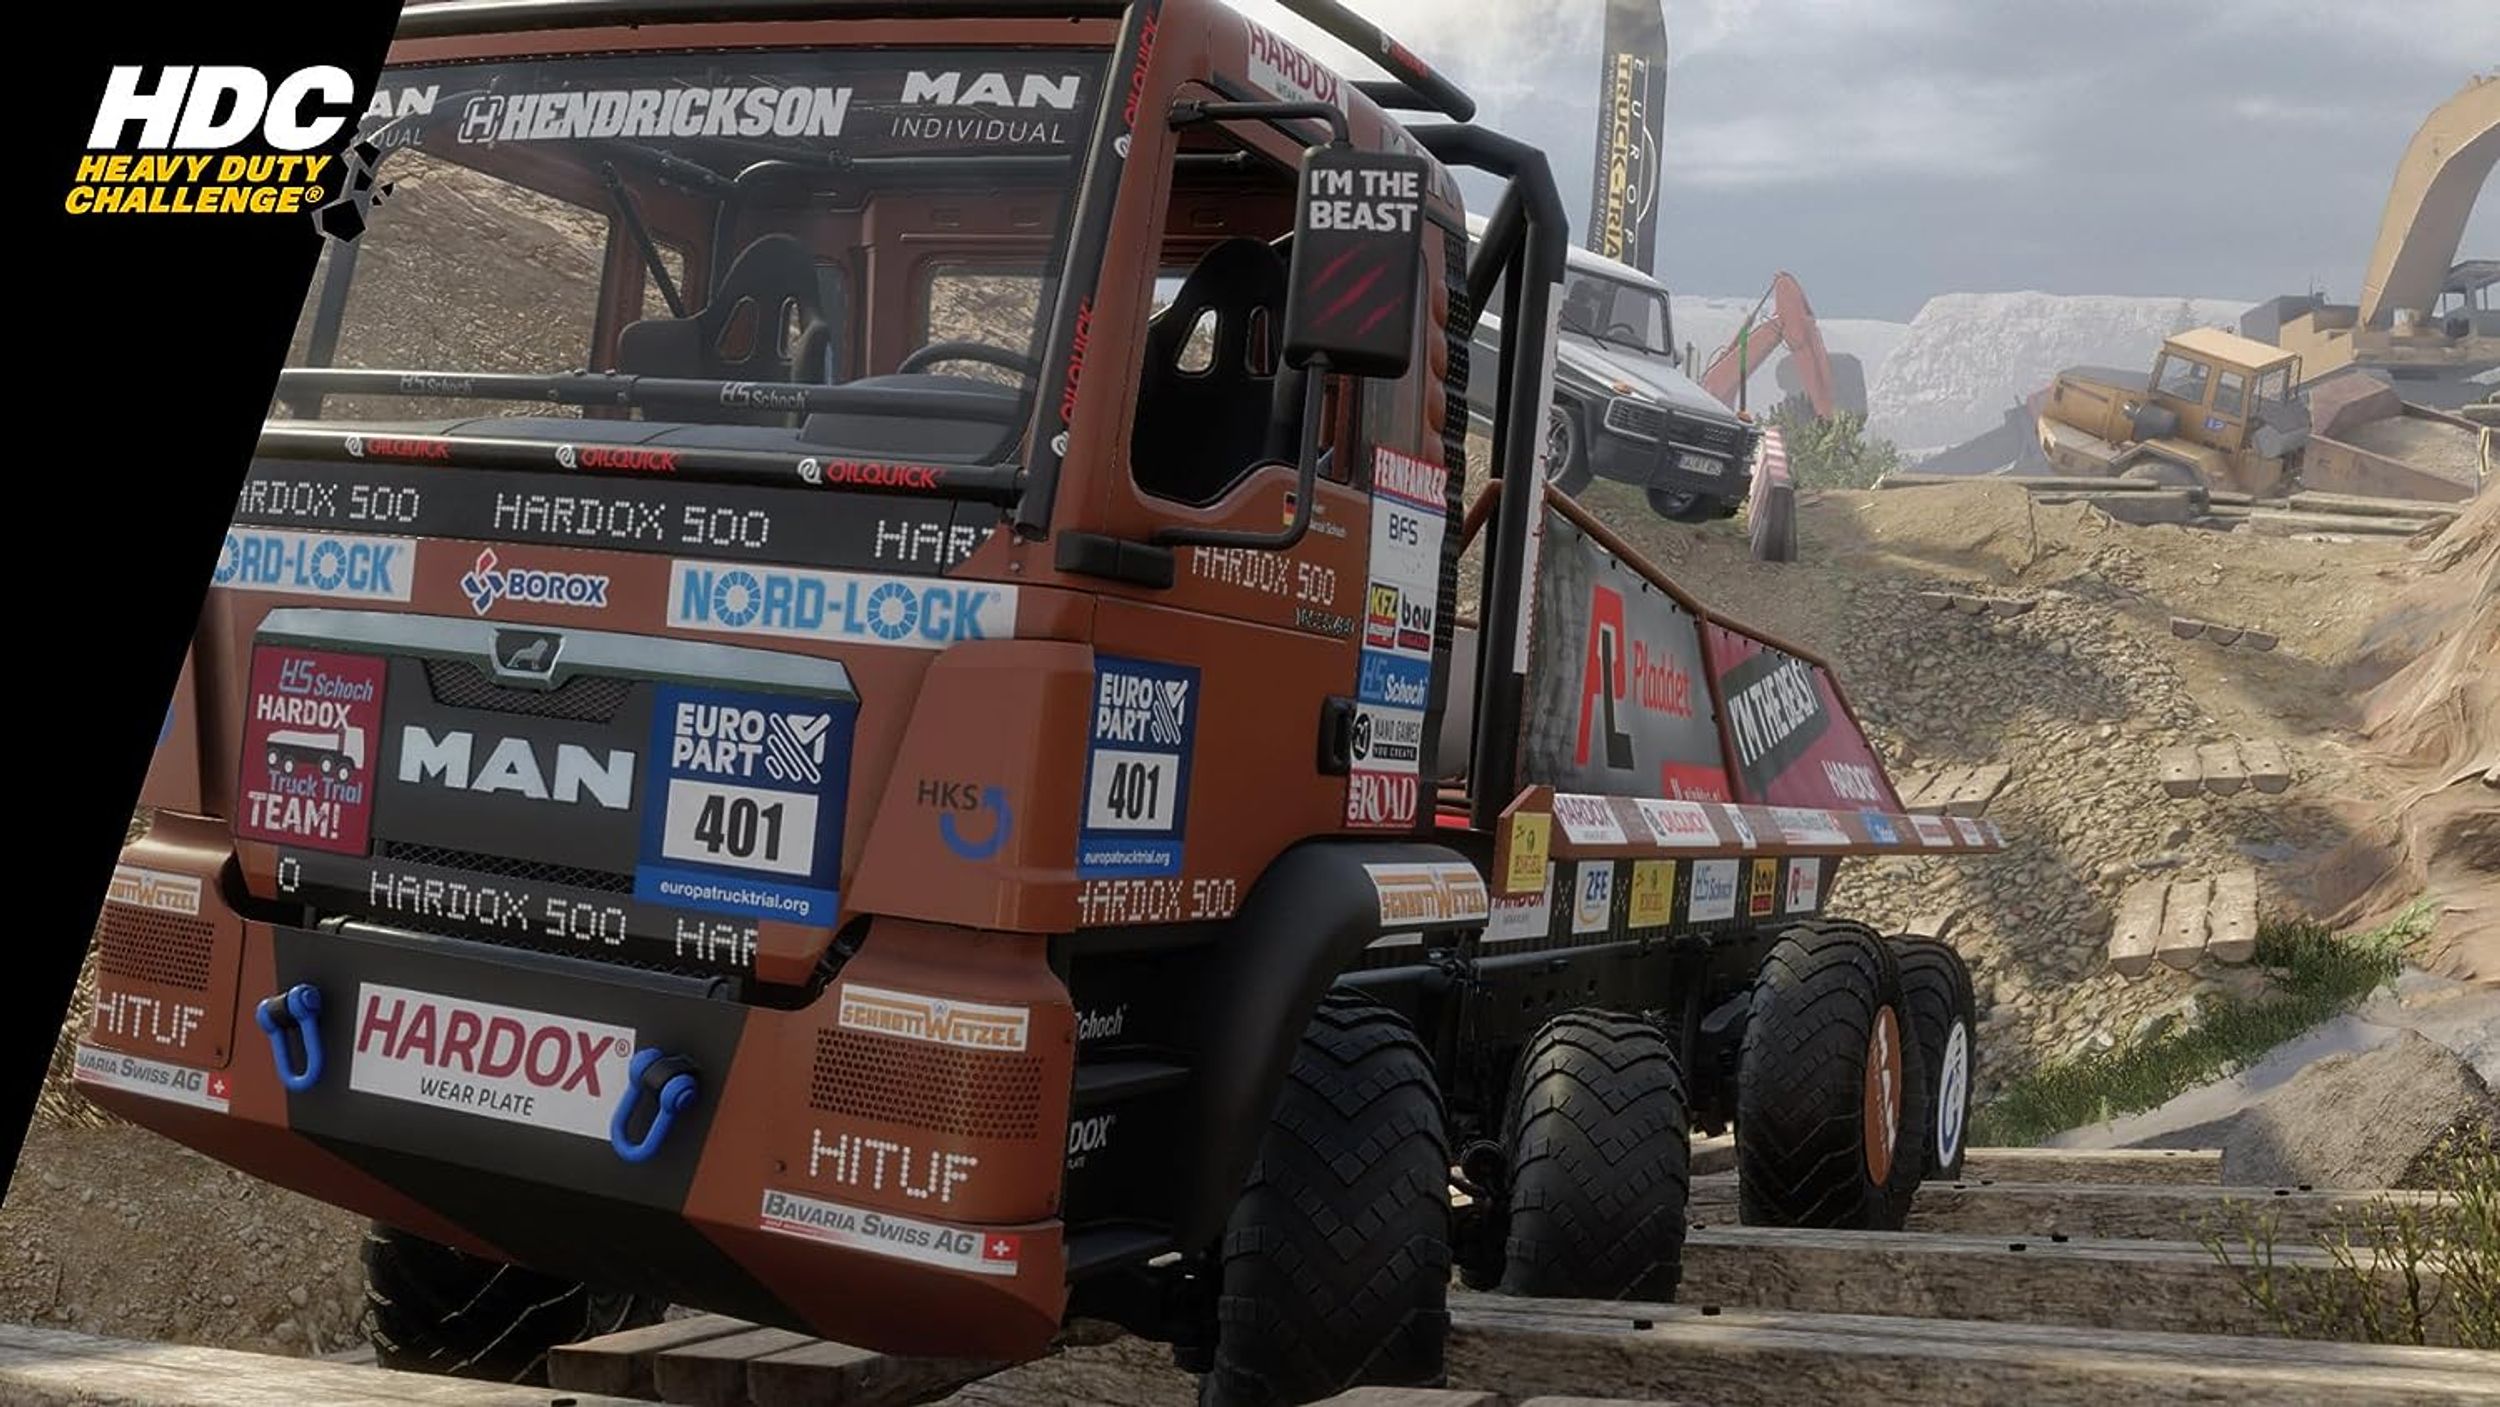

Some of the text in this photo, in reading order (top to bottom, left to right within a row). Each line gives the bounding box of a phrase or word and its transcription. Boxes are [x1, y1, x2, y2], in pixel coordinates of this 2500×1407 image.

[1248, 22, 1340, 110] HARDOX
[902, 71, 1081, 109] MAN
[500, 87, 852, 140] HENDRICKSON
[890, 117, 1066, 145] INDIVIDUAL
[1310, 169, 1419, 199] I'M THE
[1309, 200, 1418, 233] BEAST
[368, 438, 450, 460] OILQUICK
[580, 446, 676, 472] OILQUICK
[826, 462, 943, 489] OILQUICK
[349, 485, 420, 523] 500
[493, 492, 769, 548] HARDOX 500
[874, 519, 996, 564] HAR
[1389, 513, 1418, 546] BFS
[509, 572, 607, 605] BOROX
[1191, 546, 1336, 606] HARDOX 500
[680, 568, 988, 641] NORD-LOCK
[280, 658, 374, 702] HS Schoch
[1100, 673, 1153, 710] EURO
[1633, 639, 1693, 720] Pladdet
[256, 694, 351, 730] HARDOX
[674, 702, 765, 742] EURO
[1096, 706, 1150, 743] PART
[399, 725, 635, 810] MAN
[671, 736, 763, 777] PART
[268, 770, 363, 804] Truck Trial
[916, 780, 979, 811] HKS
[1107, 762, 1160, 820] 401
[1359, 775, 1417, 822] ROAD
[248, 791, 341, 840] TEAM!
[695, 794, 784, 861] 401
[1083, 850, 1171, 867] europatrucktrial.org
[370, 869, 628, 945] HARDOX 500
[660, 880, 810, 915] europatrucktrial.org
[1190, 879, 1236, 919] 500
[93, 988, 205, 1047] HITUF
[171, 1069, 203, 1092] AG
[420, 1076, 536, 1117] WEAR PLATE
[809, 1128, 979, 1203] HITUF
[933, 1230, 975, 1256] AG
